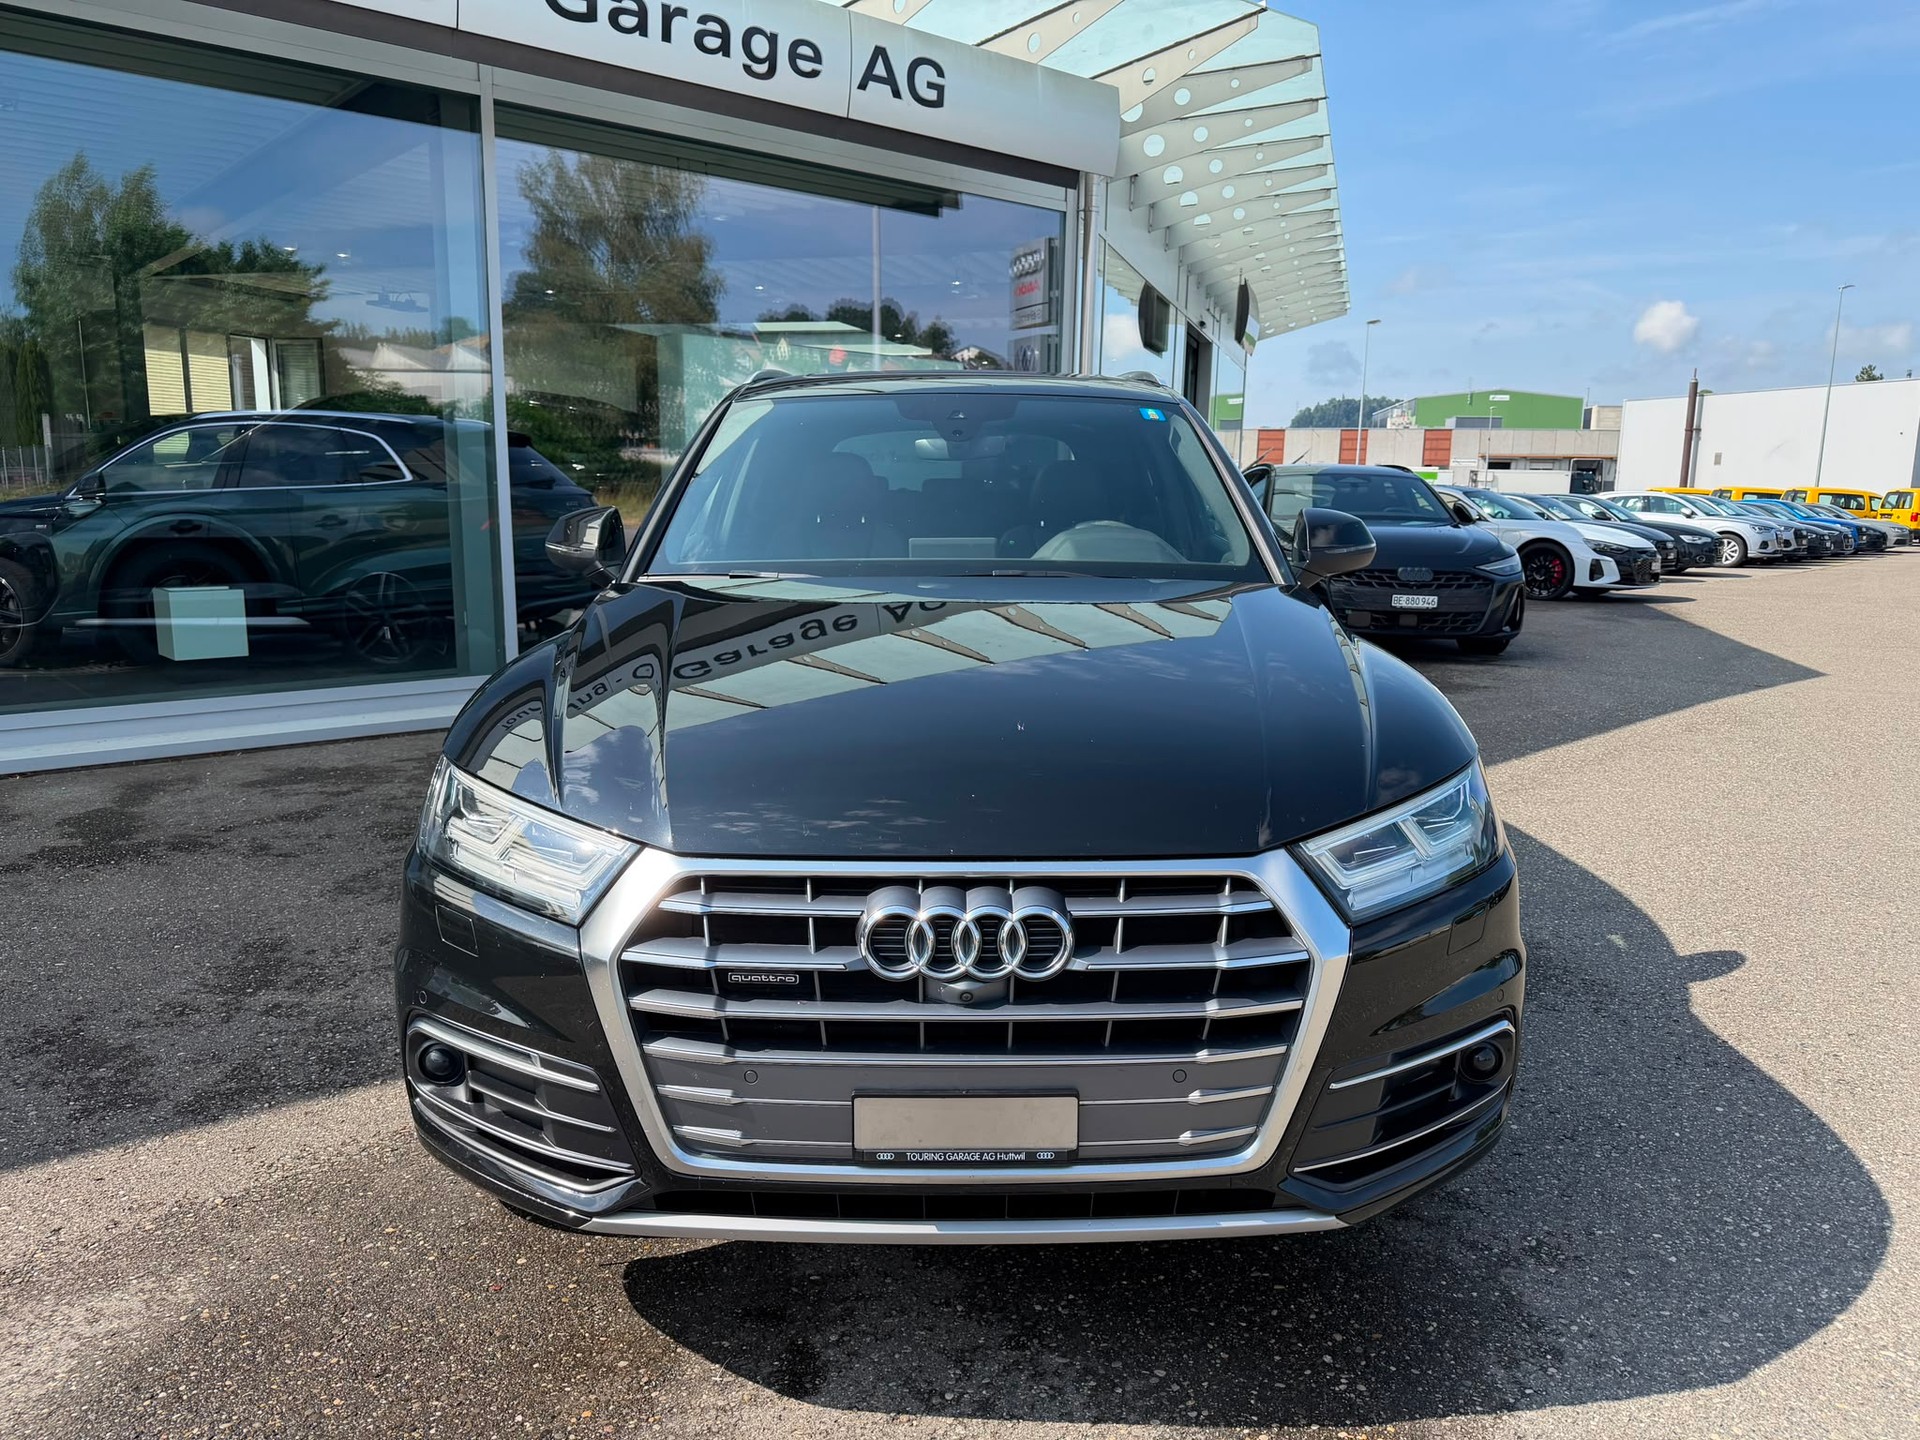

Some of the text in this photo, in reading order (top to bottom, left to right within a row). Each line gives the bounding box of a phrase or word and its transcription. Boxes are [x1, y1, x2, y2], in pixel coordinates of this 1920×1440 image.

[857, 44, 946, 109] AG
[731, 974, 795, 983] quattro
[906, 1151, 1026, 1161] TOURING GARAGE AG Huttwil
